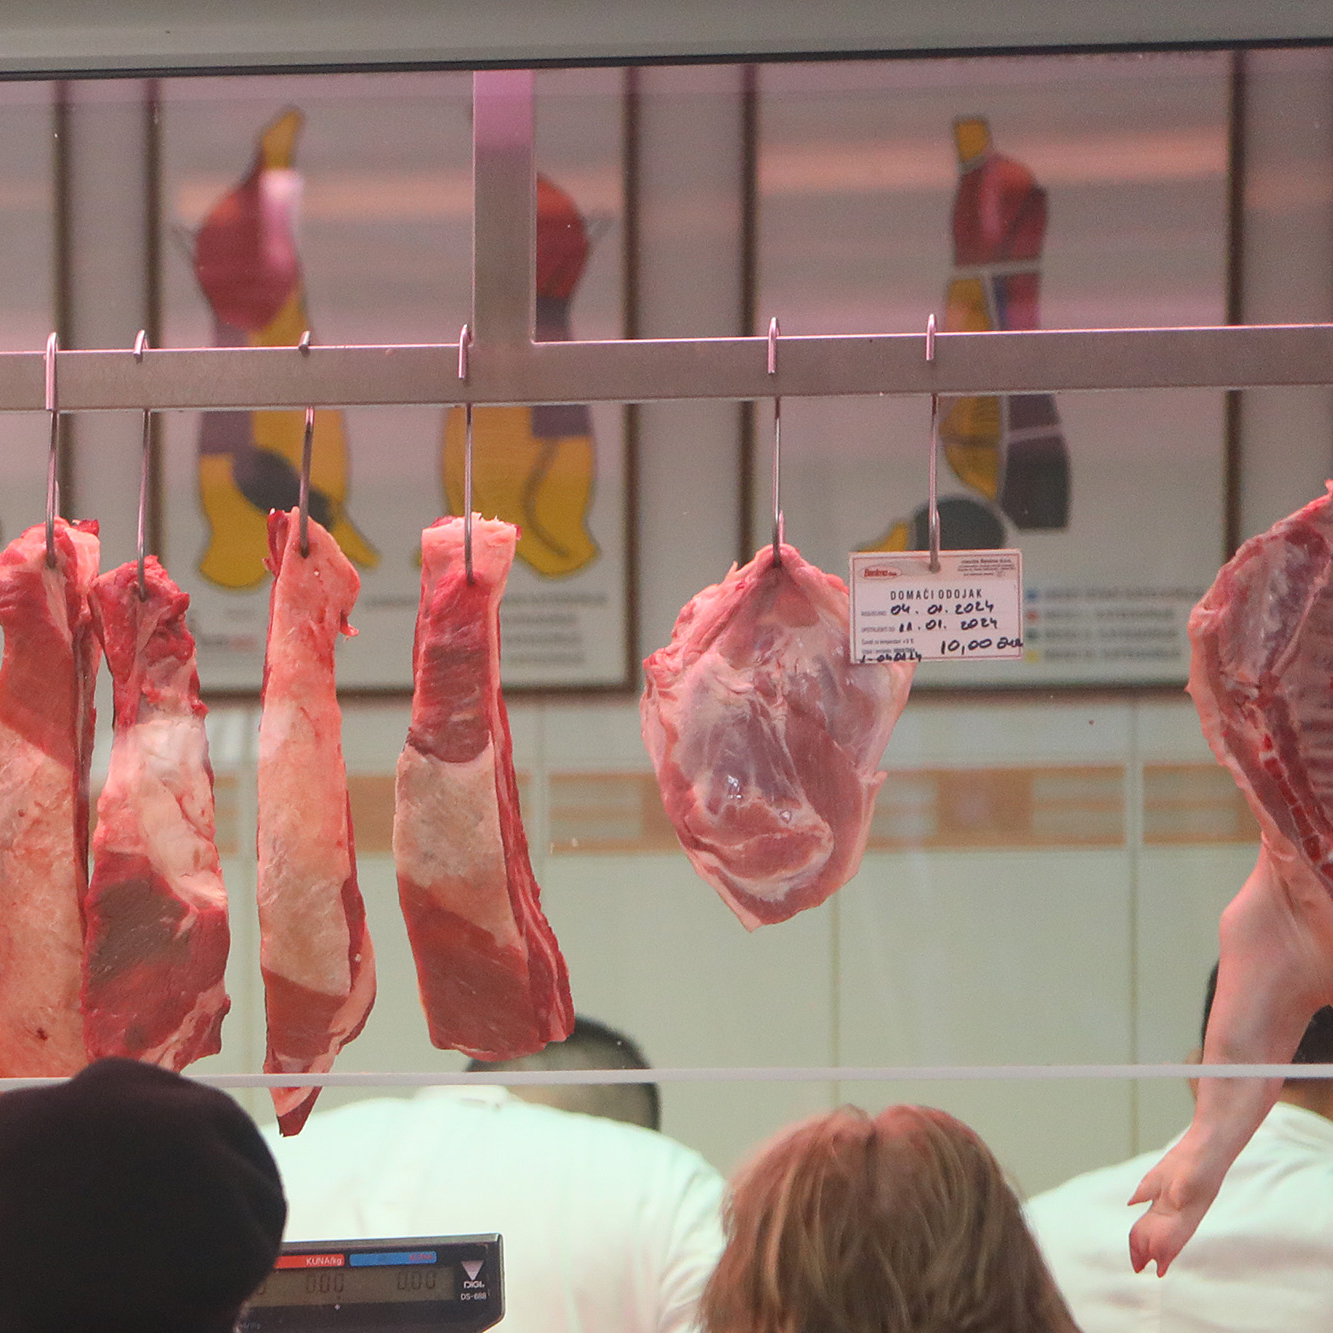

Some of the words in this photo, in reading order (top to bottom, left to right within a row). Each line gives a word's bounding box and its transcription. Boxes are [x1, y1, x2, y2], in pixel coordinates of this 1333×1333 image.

[890, 588, 933, 600] DOMAĆI
[938, 588, 982, 599] ODOJAK
[305, 1256, 343, 1267] KUNA/kg
